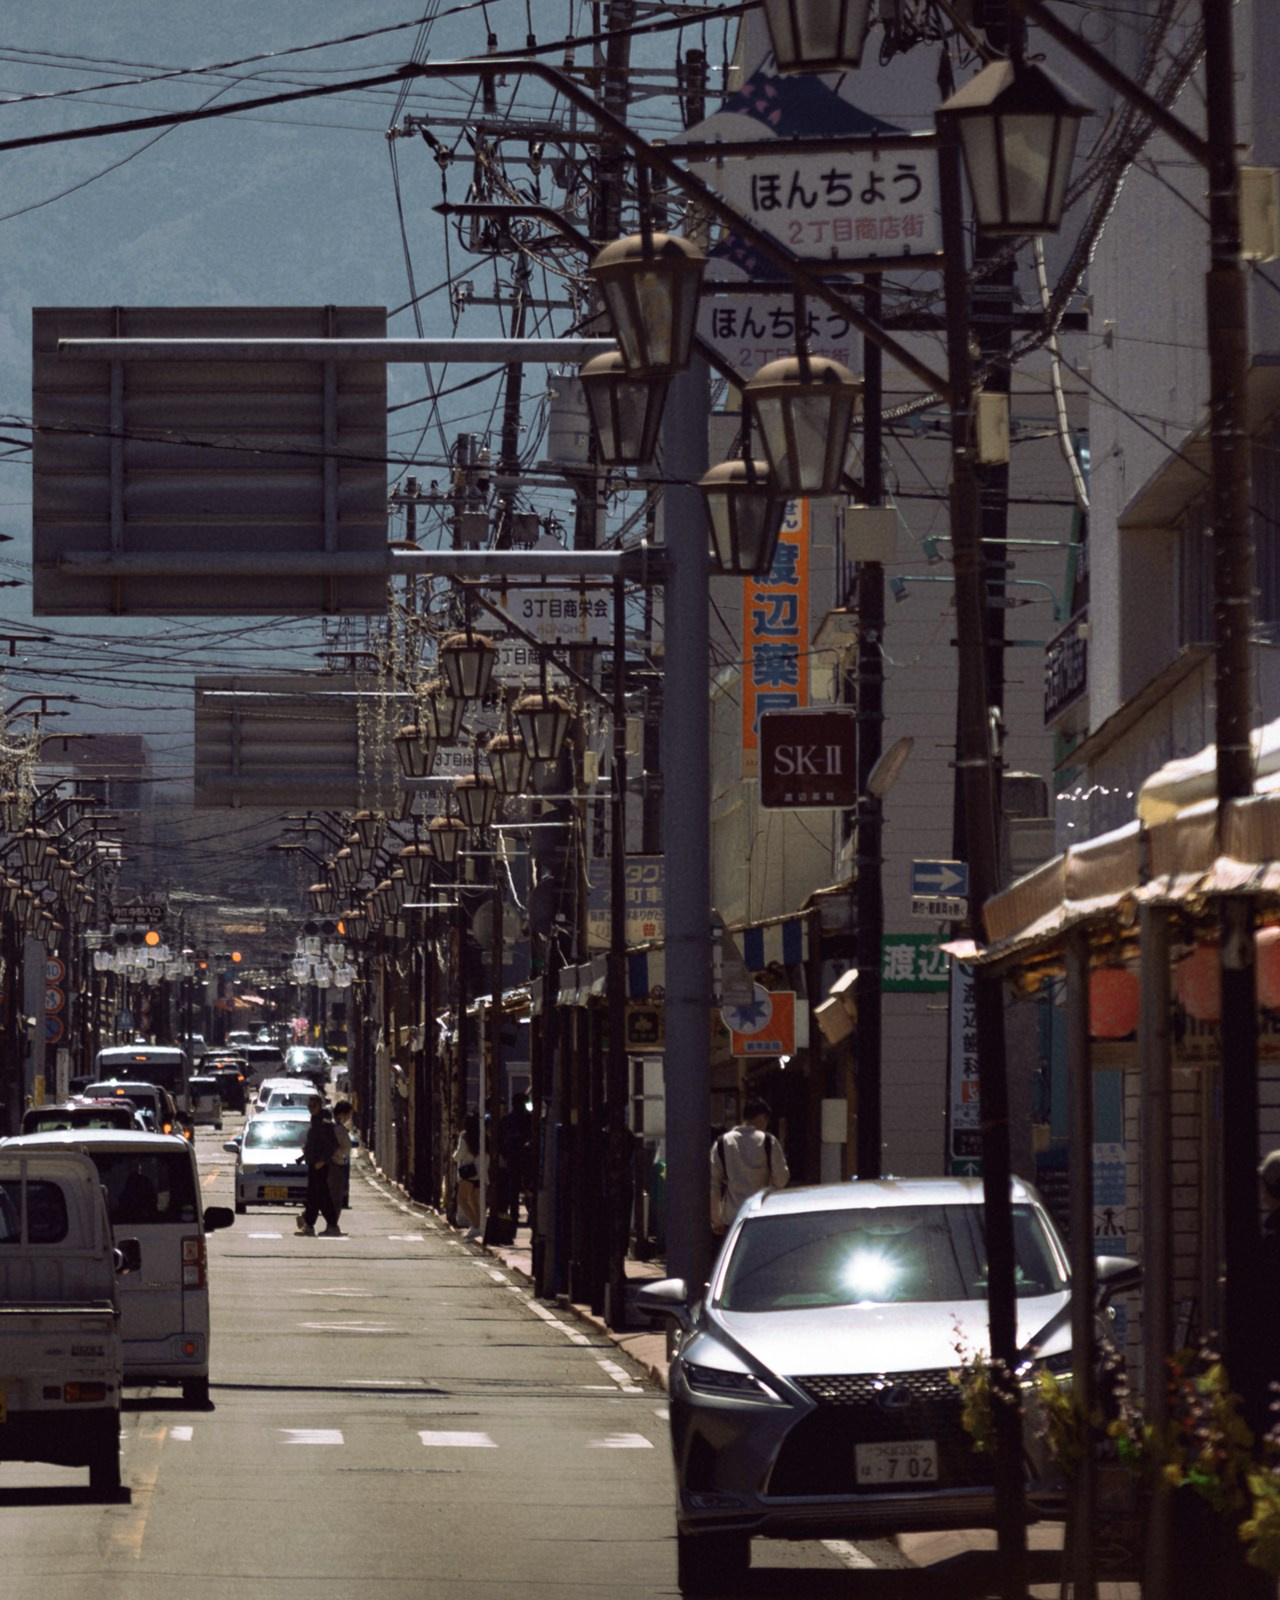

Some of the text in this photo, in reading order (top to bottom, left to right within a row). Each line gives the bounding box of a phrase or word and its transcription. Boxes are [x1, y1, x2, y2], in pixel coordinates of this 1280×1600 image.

[751, 163, 922, 212] ほんちょう
[788, 215, 925, 245] 2丁目商店街
[523, 598, 608, 619] 3丁目商栄会
[774, 744, 843, 776] SK-II
